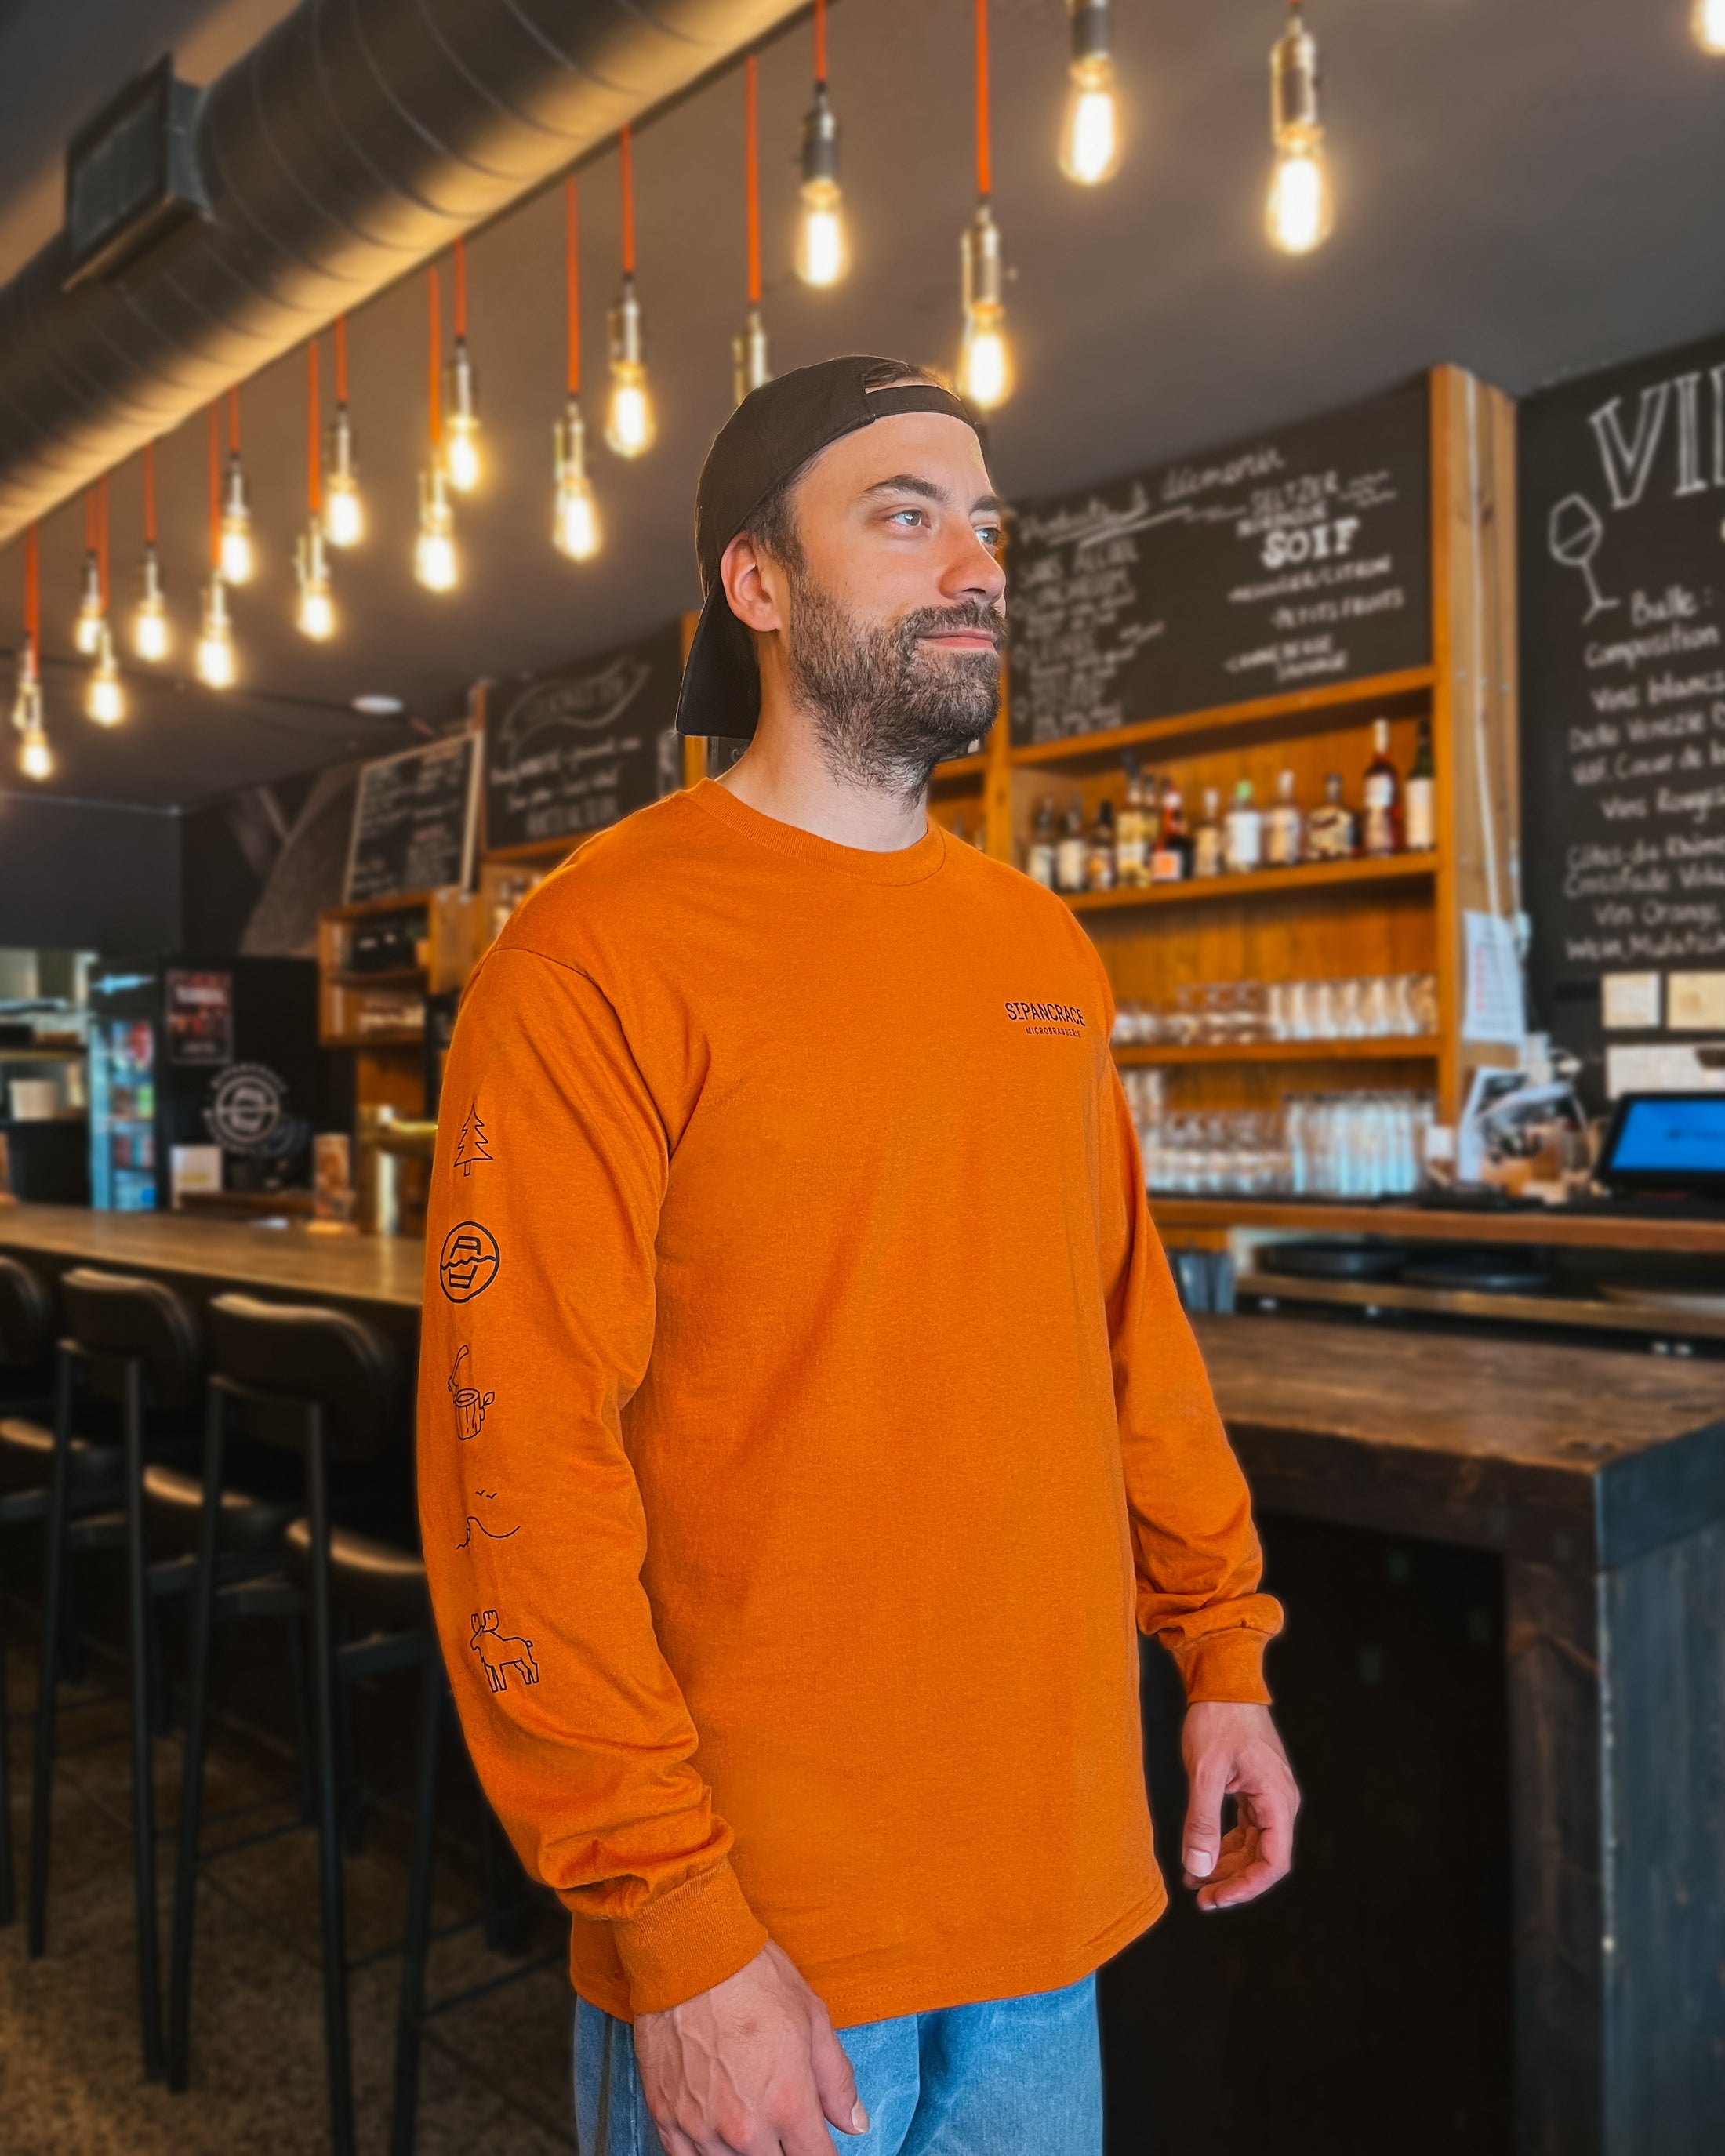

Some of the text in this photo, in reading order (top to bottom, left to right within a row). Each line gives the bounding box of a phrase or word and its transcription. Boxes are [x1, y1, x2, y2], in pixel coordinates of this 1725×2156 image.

[1262, 517, 1360, 570] SOIF
[1583, 623, 1720, 671] Composition
[1025, 1026, 1082, 1039] MICROBRASSERIE
